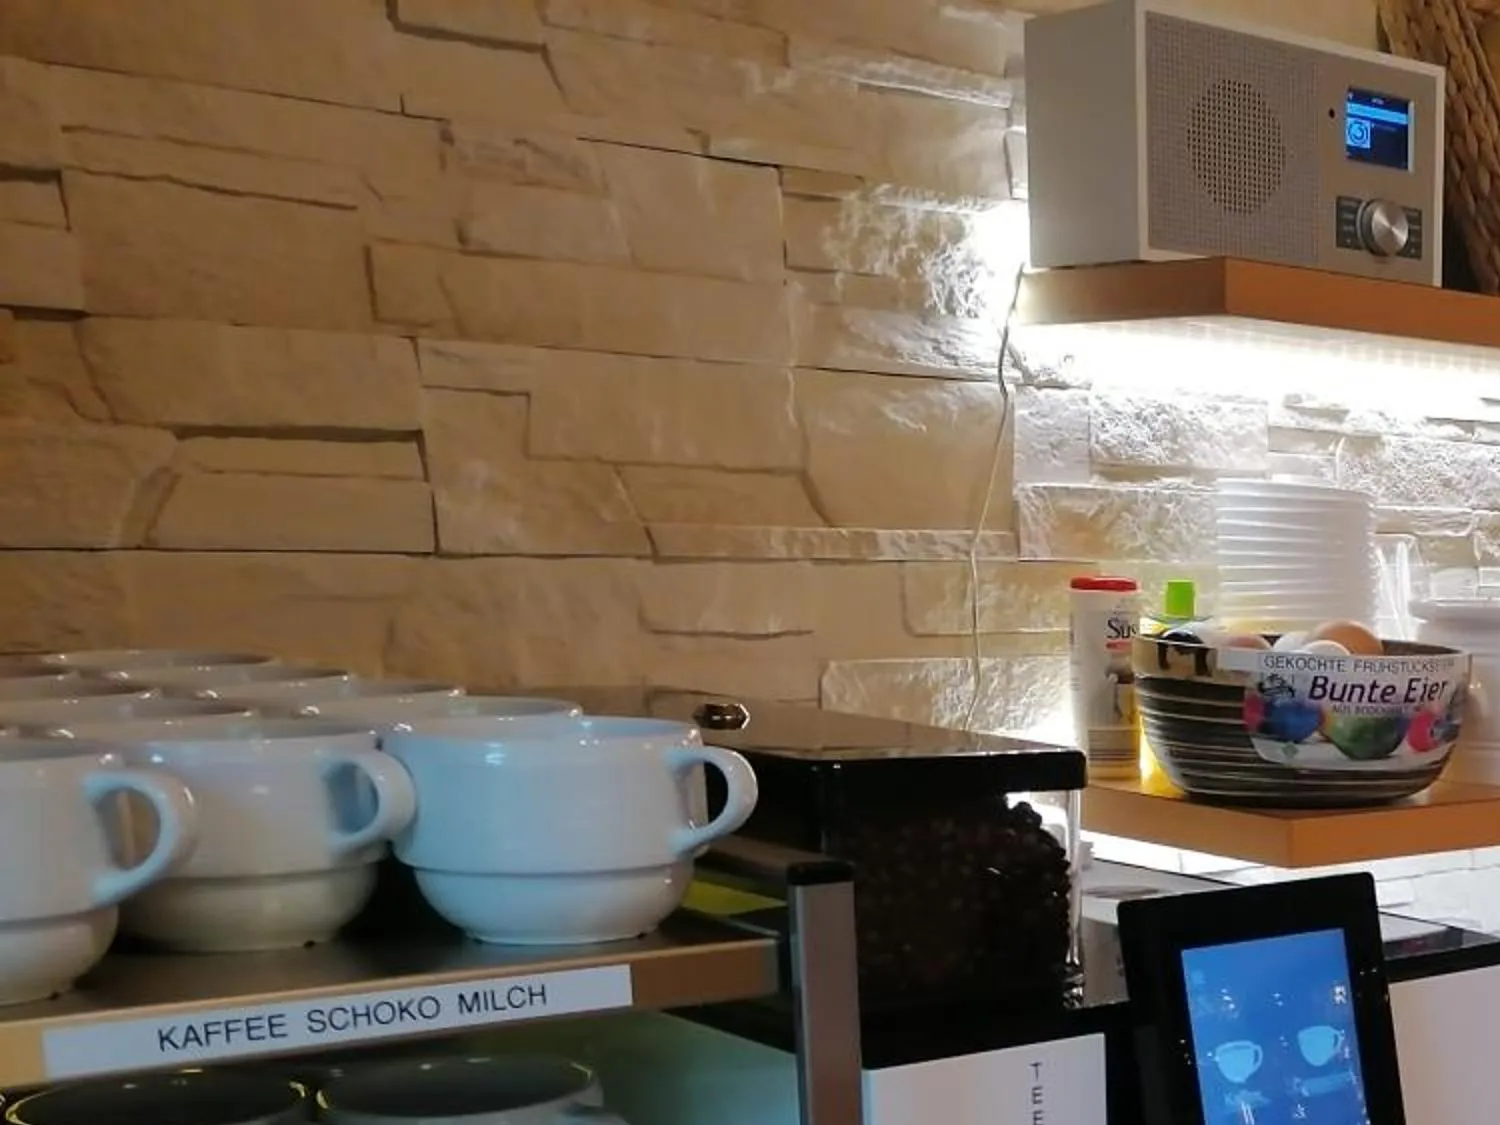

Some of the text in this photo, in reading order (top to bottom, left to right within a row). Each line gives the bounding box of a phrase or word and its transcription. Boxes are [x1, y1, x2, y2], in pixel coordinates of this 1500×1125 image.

[1263, 655, 1346, 674] GEKOCHTE
[1308, 675, 1449, 705] Bunte Eier
[157, 982, 548, 1053] KAFFEE SCHOKO MILCH
